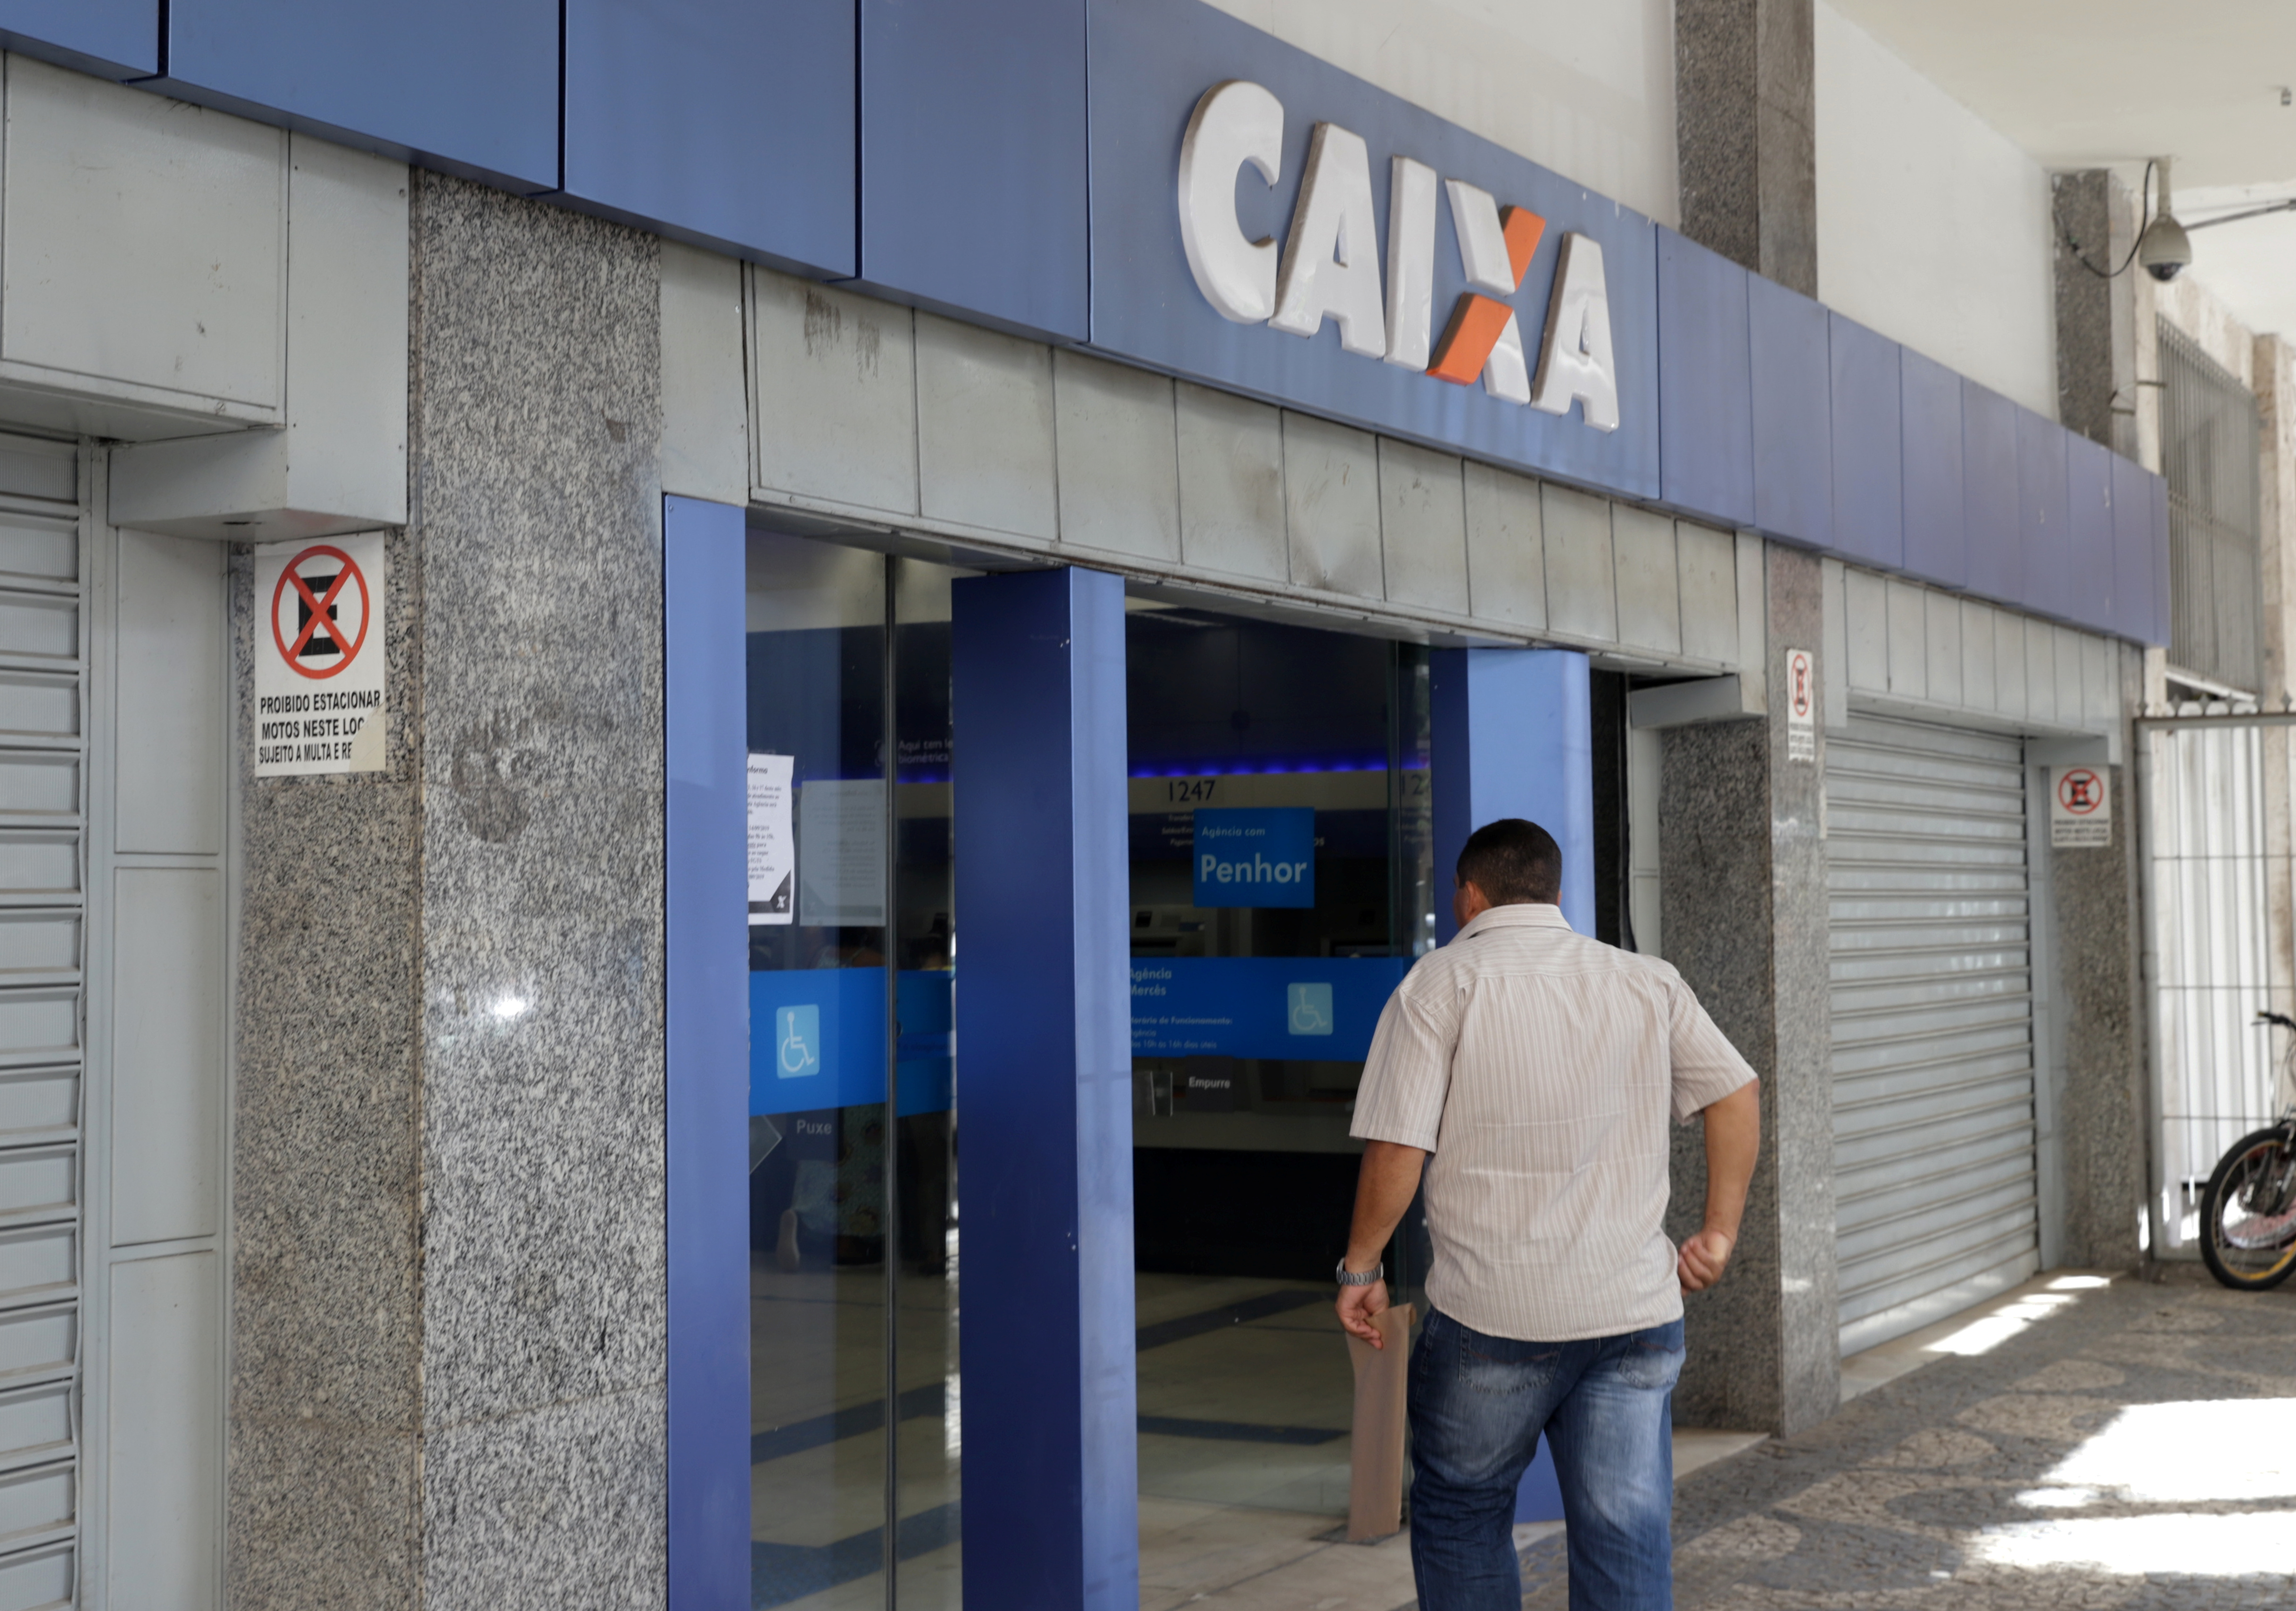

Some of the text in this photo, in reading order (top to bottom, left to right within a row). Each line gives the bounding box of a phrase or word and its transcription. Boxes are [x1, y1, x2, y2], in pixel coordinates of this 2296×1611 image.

[1177, 79, 1619, 432] CAIXA
[260, 689, 380, 714] PROIBIDO ESTACIONAR
[262, 721, 299, 740] MOTOS
[304, 718, 339, 738] NESTE
[259, 744, 293, 764] SUJEITO
[296, 744, 301, 762] A
[304, 742, 331, 762] MULTA
[334, 741, 339, 760] E
[1169, 780, 1216, 802] 1247
[1202, 826, 1242, 839] Agência
[1244, 828, 1266, 837] com
[1201, 852, 1307, 883] Penhor
[1188, 1076, 1231, 1090] Empurre
[796, 1119, 832, 1135] Puxe
